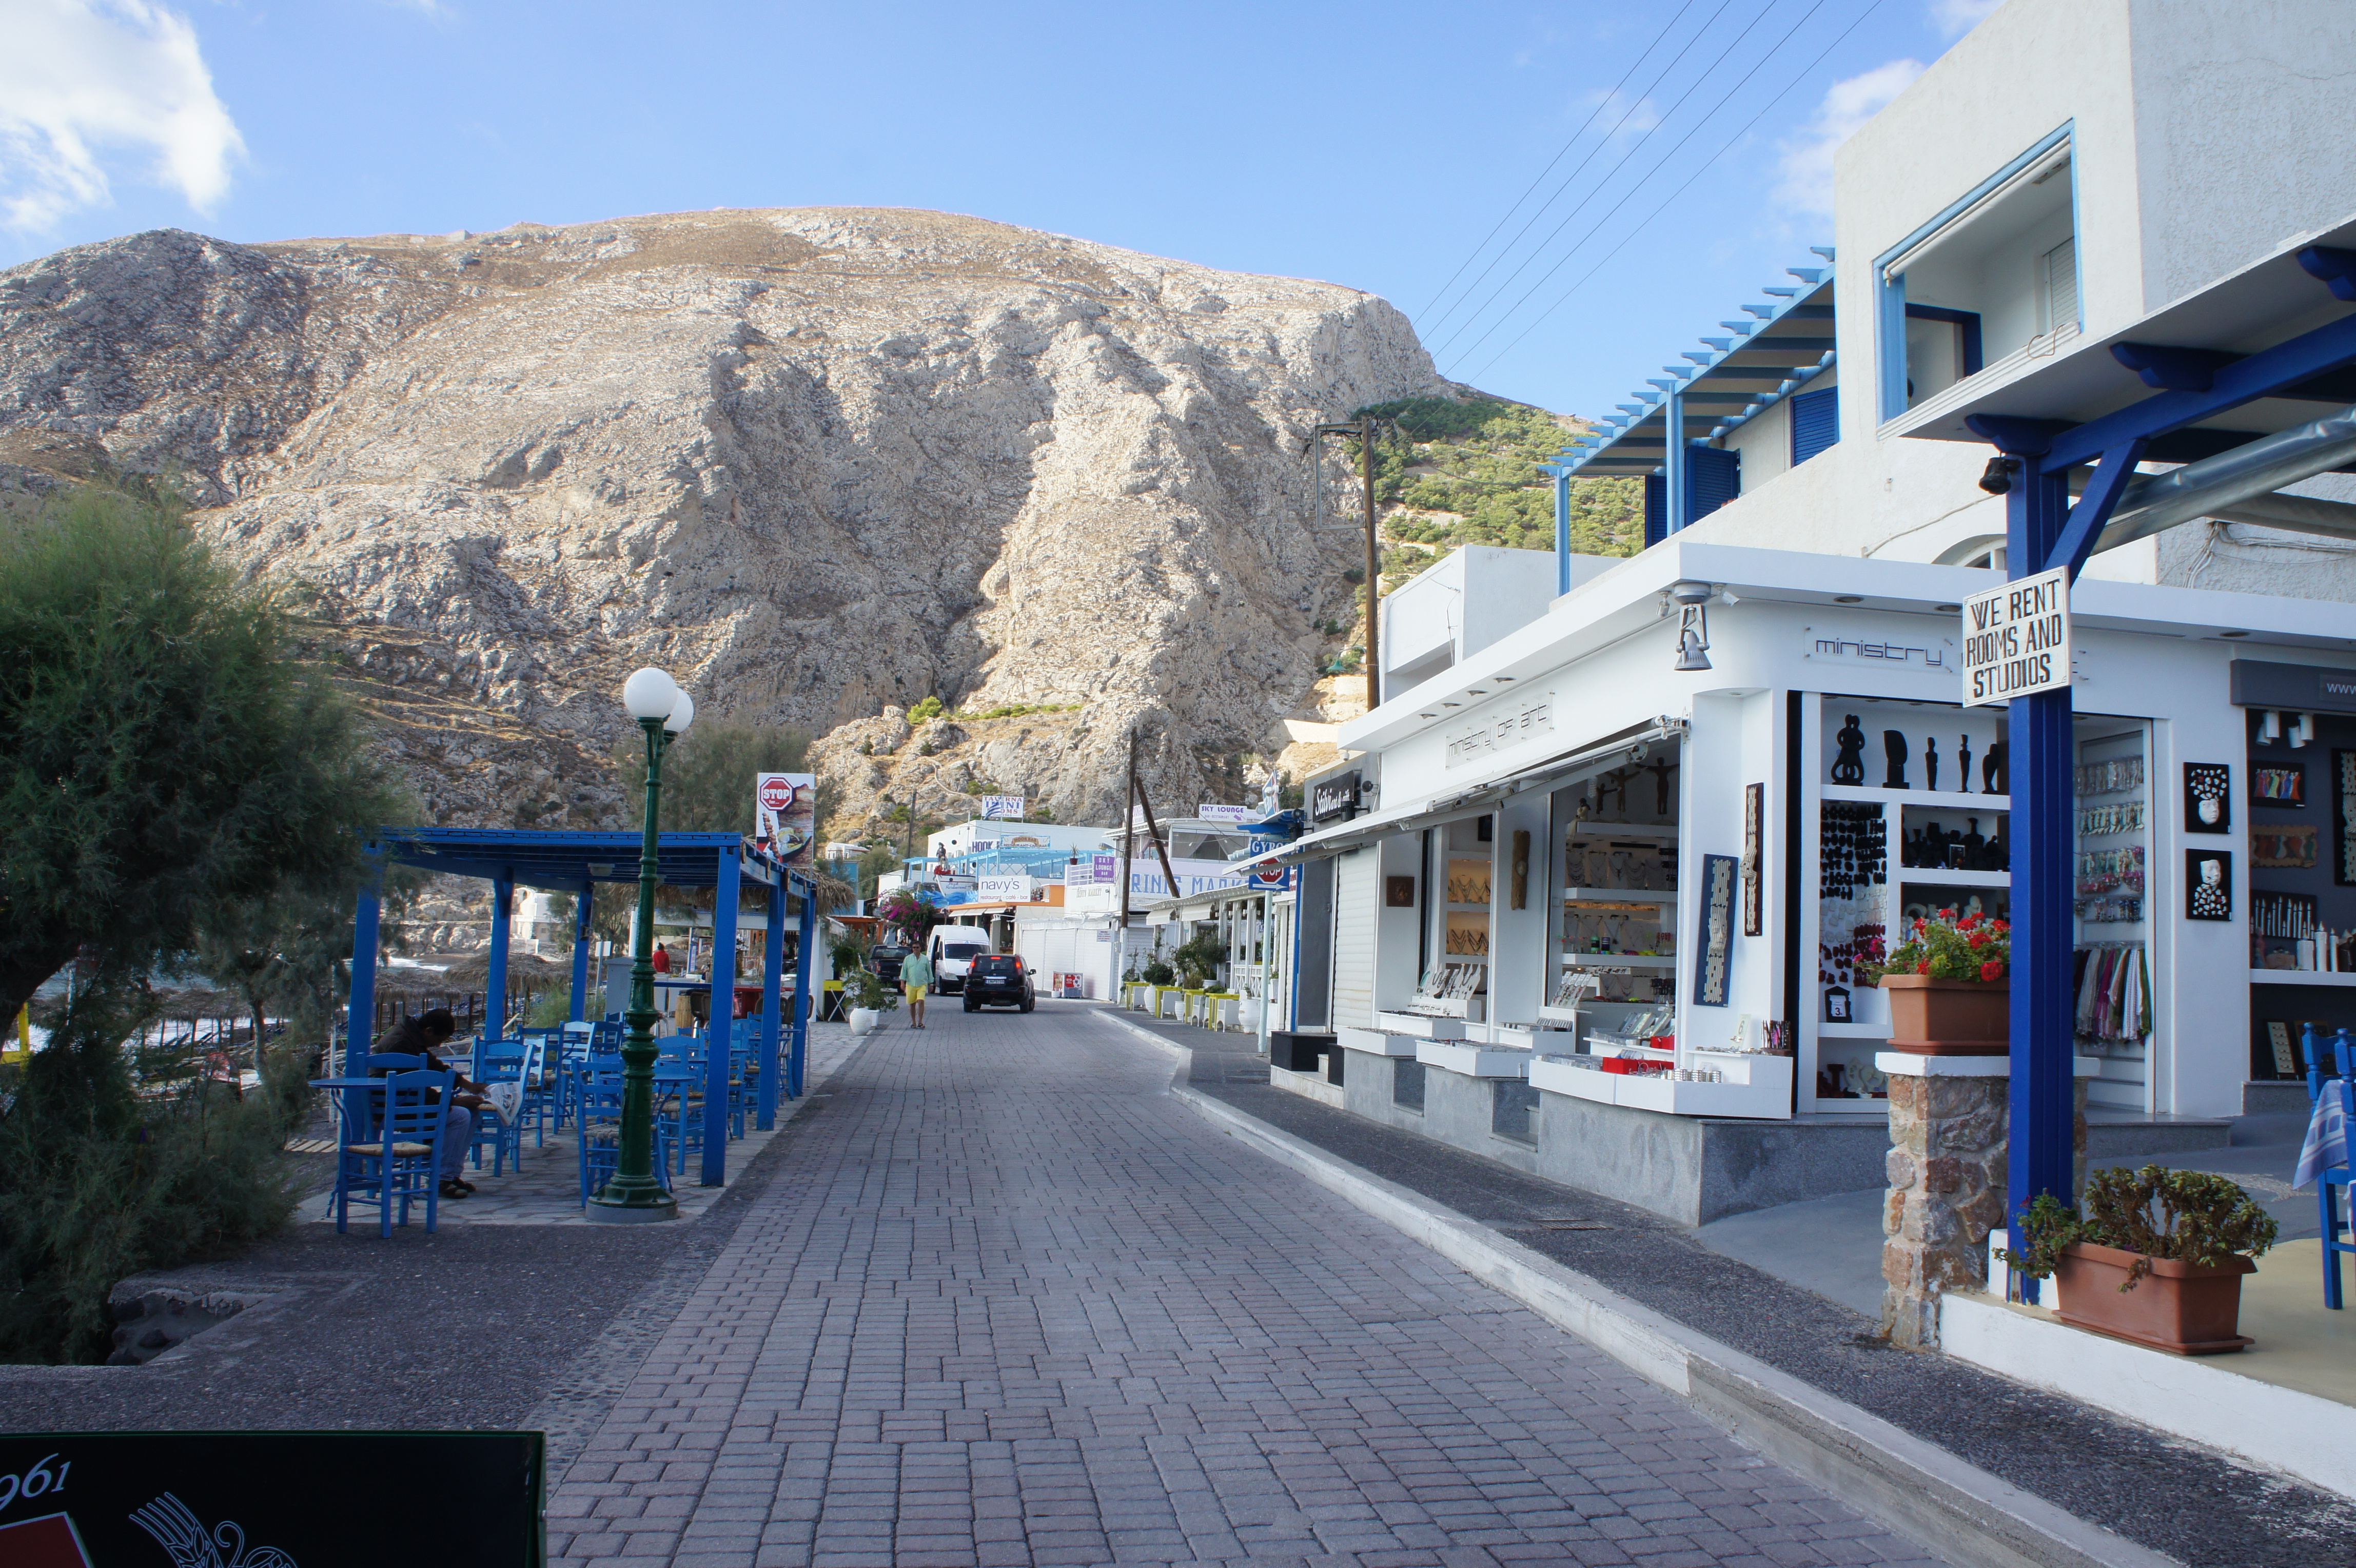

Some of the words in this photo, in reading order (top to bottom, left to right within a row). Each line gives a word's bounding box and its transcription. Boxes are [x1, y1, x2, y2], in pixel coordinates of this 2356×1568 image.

[1970, 596, 2002, 631] WE
[2009, 578, 2060, 622] RENT
[1816, 637, 1941, 666] ministry
[1966, 625, 2017, 668] ROOMS
[2025, 614, 2062, 654] AND
[1973, 653, 2051, 698] STUDIOS
[1448, 727, 1491, 757] ministry
[1521, 702, 1547, 729] art
[763, 789, 790, 799] STOP
[972, 840, 993, 853] HOOK
[1252, 841, 1289, 853] GYRO
[981, 878, 1019, 893] navy's
